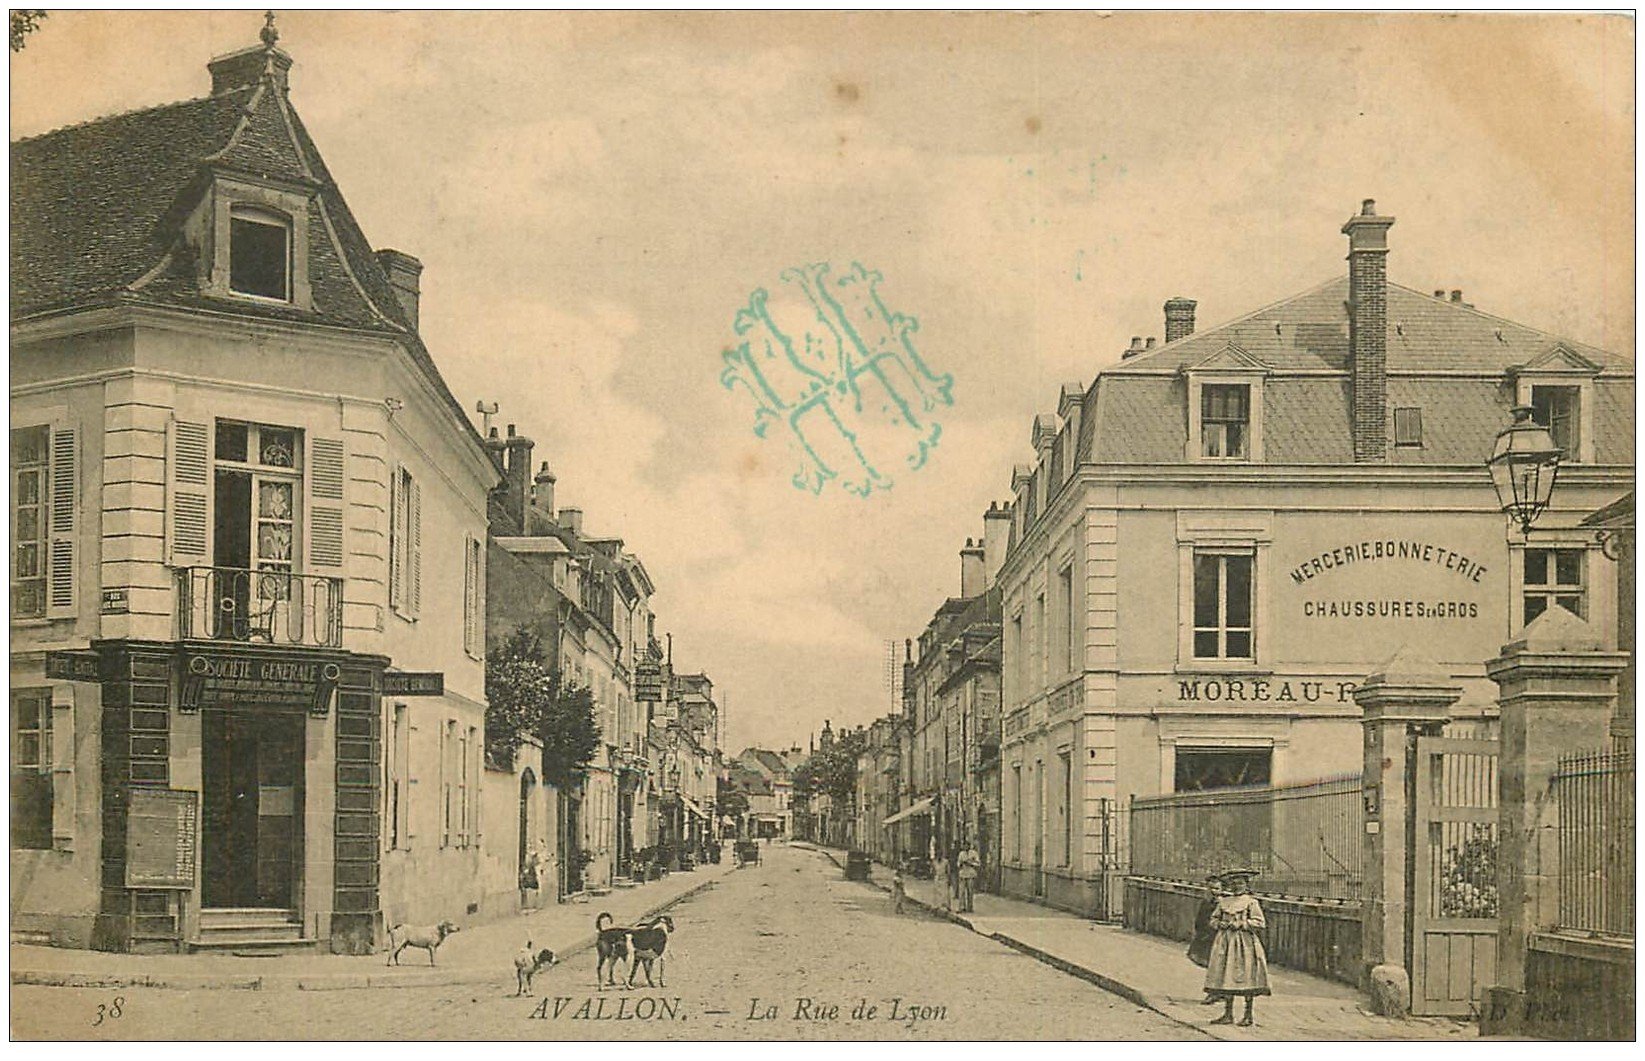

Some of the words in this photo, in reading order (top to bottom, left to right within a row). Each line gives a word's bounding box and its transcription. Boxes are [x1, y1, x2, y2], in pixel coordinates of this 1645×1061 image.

[1375, 541, 1488, 583] BONNETERIE
[1304, 601, 1425, 618] CHAUSSURES
[1437, 602, 1478, 618] GROS
